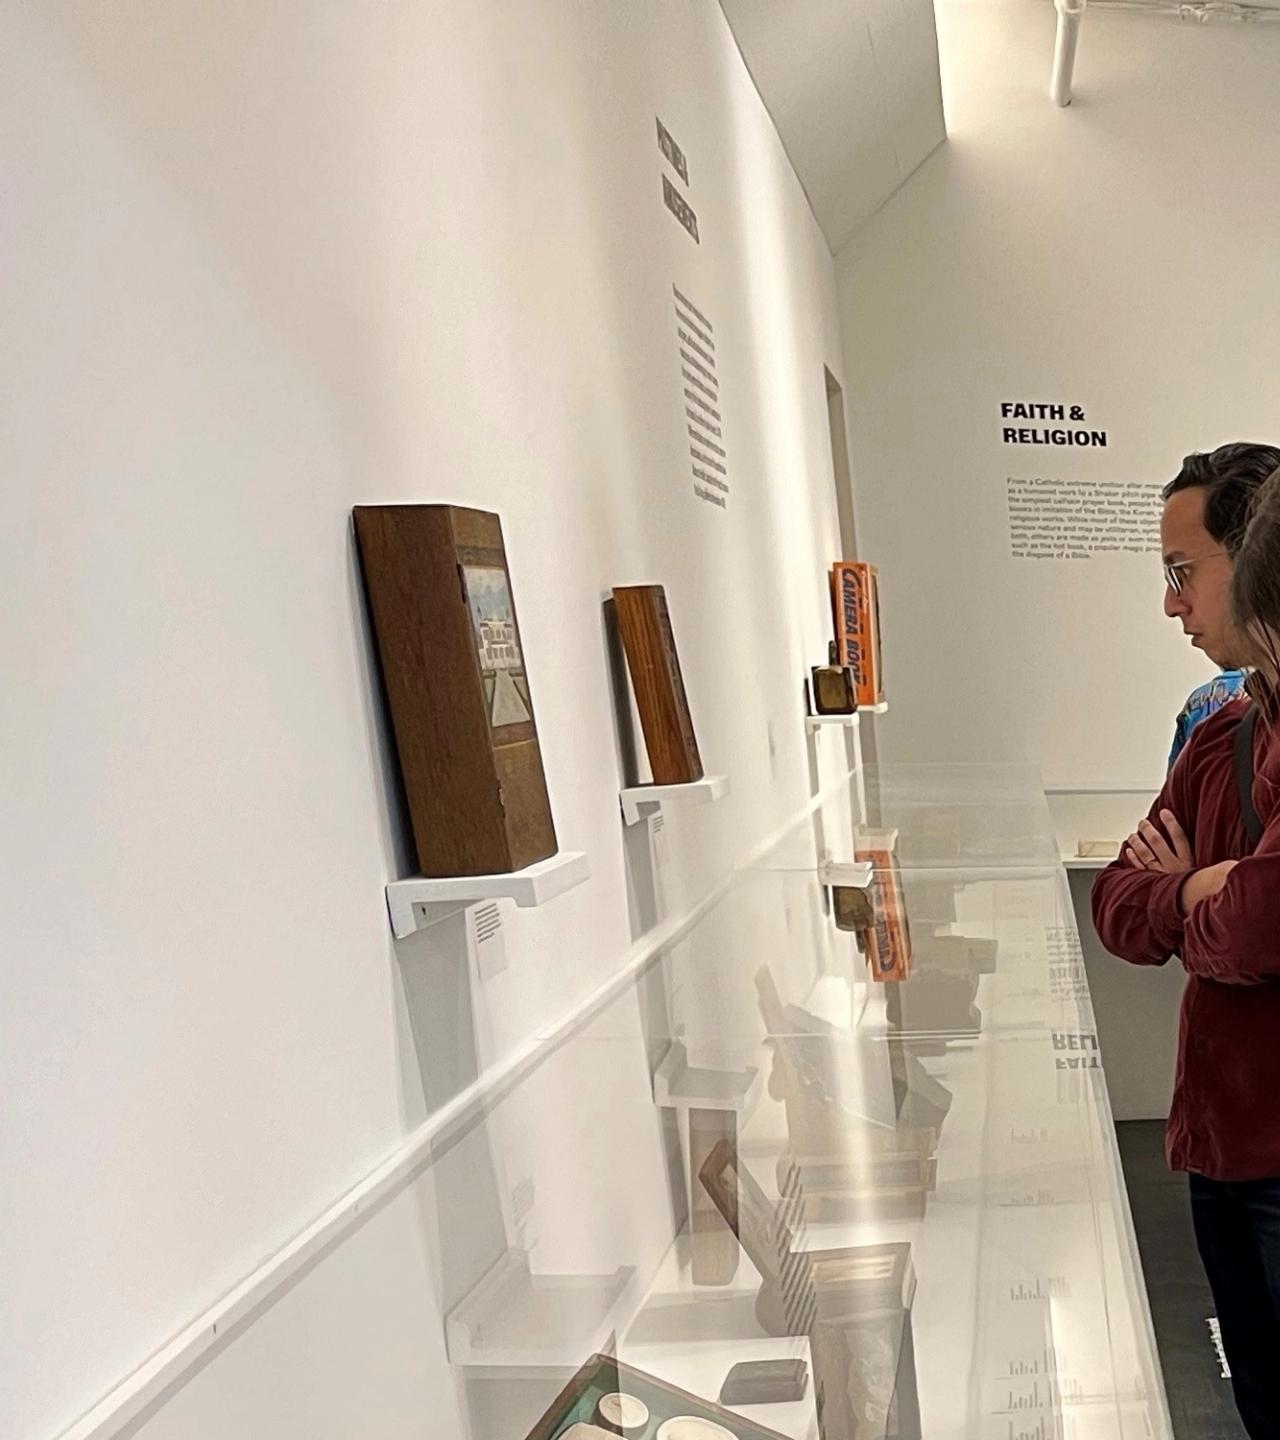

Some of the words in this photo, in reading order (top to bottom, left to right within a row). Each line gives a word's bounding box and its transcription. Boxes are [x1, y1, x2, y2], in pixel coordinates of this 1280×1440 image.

[1001, 403, 1064, 420] FAITH
[1069, 406, 1085, 421] &
[1003, 428, 1107, 447] RELIGION
[842, 568, 863, 636] CAMERA
